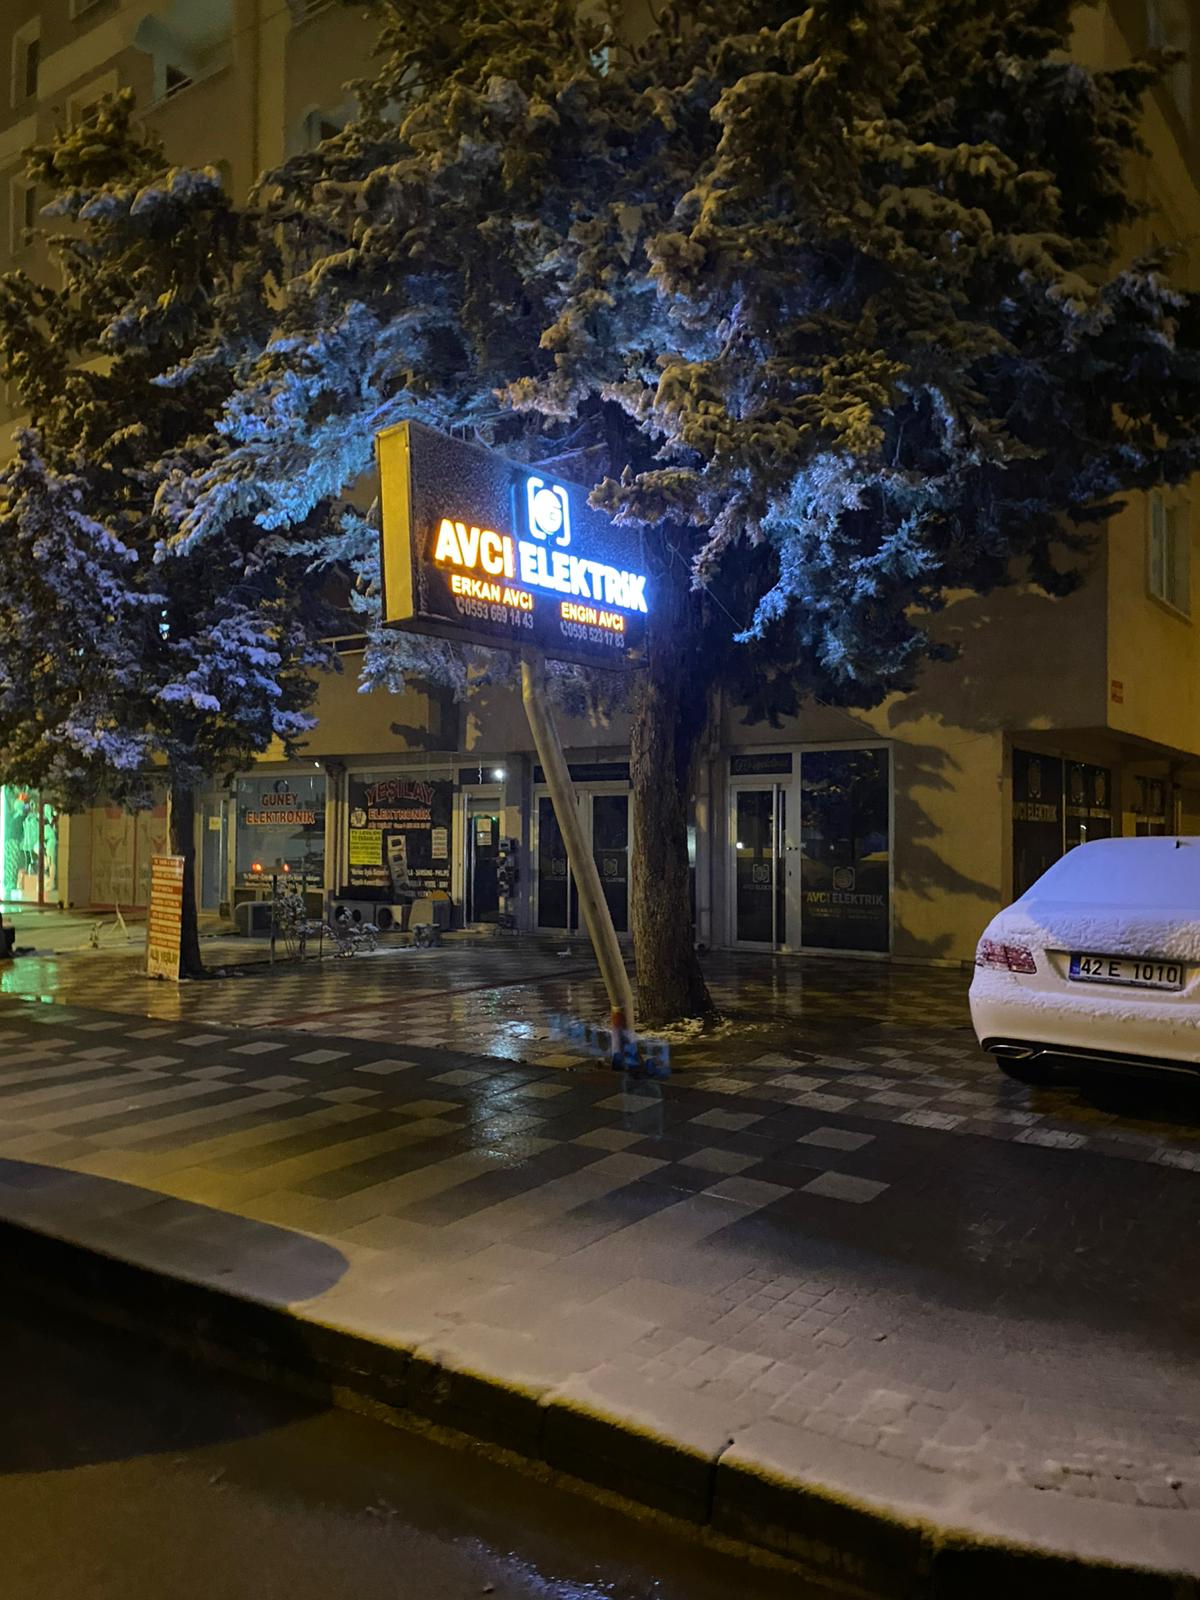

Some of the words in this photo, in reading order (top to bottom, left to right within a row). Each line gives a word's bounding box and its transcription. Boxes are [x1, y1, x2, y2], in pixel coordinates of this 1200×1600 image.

[434, 518, 514, 578] AVCI
[451, 574, 501, 603] ERKAN
[502, 587, 533, 610] AVCI
[465, 600, 489, 620] 0553
[510, 608, 521, 628] 14
[522, 612, 534, 630] 43
[598, 610, 624, 632] AVCI
[806, 891, 831, 904] AVCI
[1081, 958, 1103, 976] 42
[1108, 961, 1122, 977] E
[1133, 963, 1179, 983] 1010
